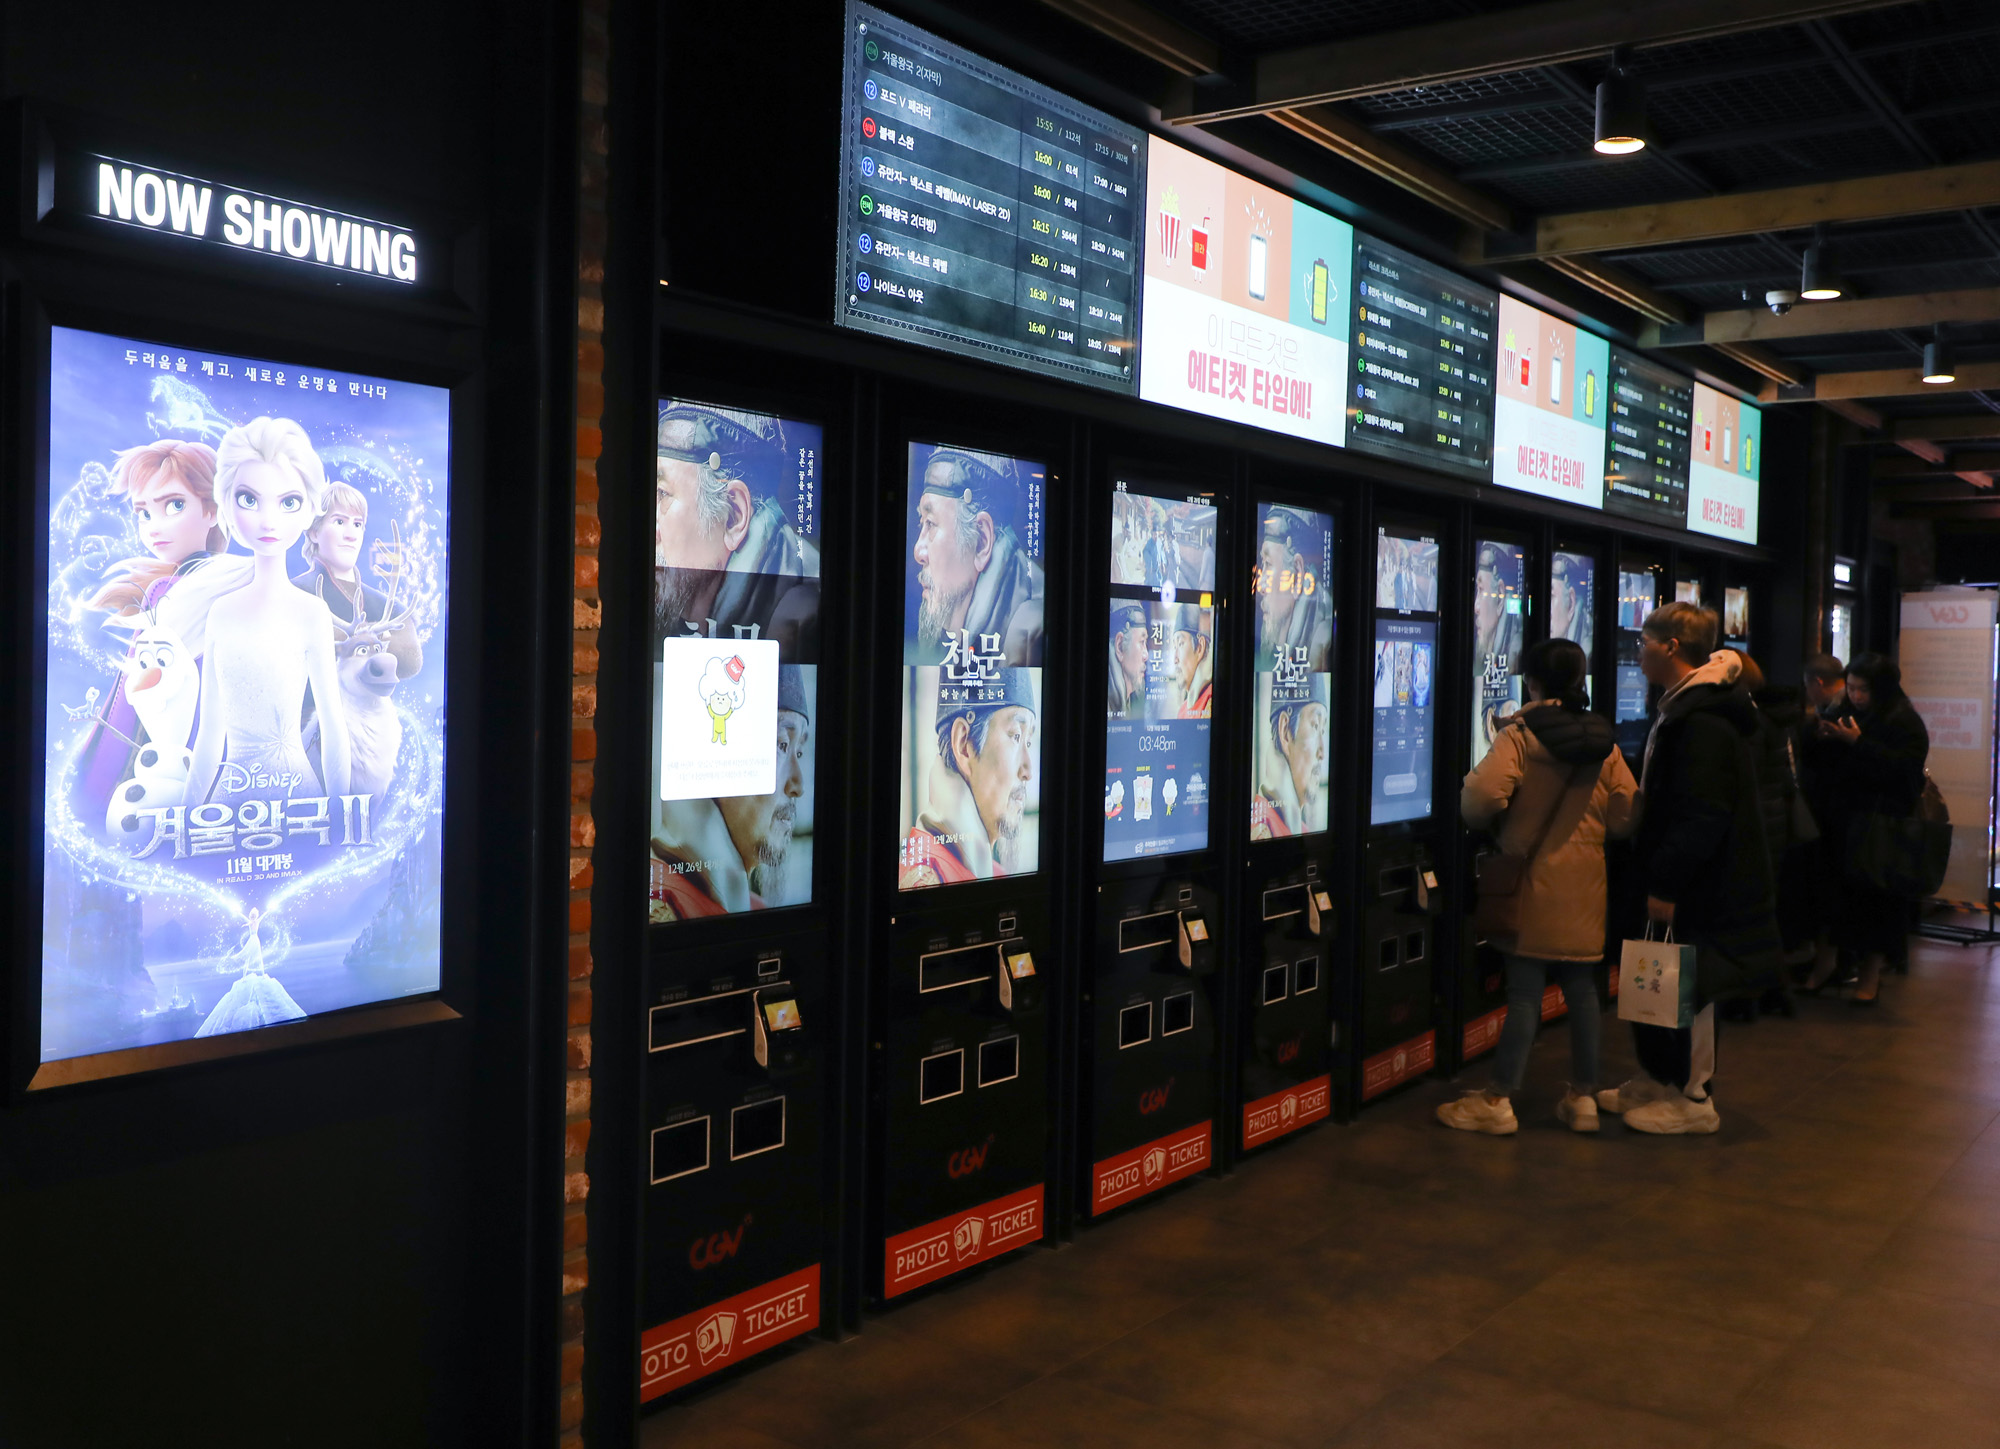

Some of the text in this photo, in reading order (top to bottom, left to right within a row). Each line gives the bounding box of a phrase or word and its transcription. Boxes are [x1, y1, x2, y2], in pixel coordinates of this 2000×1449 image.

[882, 50, 942, 86] 겨울왕국 2(자막)
[880, 88, 932, 120] 포드 V 페라리
[879, 126, 914, 151] 블랙 스완
[1036, 117, 1054, 132] 15:55
[1034, 150, 1053, 166] 16:00
[910, 175, 934, 194] 넥스트
[935, 184, 972, 208] 레벨(IMAX
[973, 198, 997, 217] LASER
[998, 206, 1010, 222] 2D)
[1033, 184, 1052, 200] 16:00
[98, 163, 417, 283] NOW SHOWING
[876, 203, 937, 234] 겨울왕국 2(더빙)
[1032, 219, 1050, 234] 16:15
[908, 250, 930, 268] 넥스트
[932, 258, 948, 274] 레벨
[1030, 254, 1048, 268] 16:20
[874, 278, 924, 304] 나이브스 아웃
[1030, 288, 1048, 302] 16:30
[1028, 322, 1046, 336] 16:40
[124, 350, 388, 400] 두려움을 깨고, 새로운 운명을 만나다
[1187, 350, 1312, 420] 에티켓 타임에!
[1517, 444, 1584, 490] 에티켓 타임에!
[806, 514, 812, 534] 시간
[1702, 498, 1722, 526] 에티켓
[796, 526, 804, 536] 두
[939, 628, 1006, 680] 천문
[1150, 620, 1164, 672] 천문
[1272, 642, 1310, 682] 천문
[940, 688, 969, 700] 하늘에
[1138, 735, 1176, 752] 03:48pm
[130, 794, 376, 860] 겨울왕국 II
[946, 833, 958, 844] 26일
[226, 853, 293, 874] 11월 대개봉
[668, 860, 703, 875] 12월 26일
[1248, 1091, 1326, 1132] PHOTO TICKET
[948, 1142, 988, 1180] CGV
[1100, 1140, 1204, 1195] PHOTO TICKET
[689, 1224, 745, 1270] CGV
[896, 1207, 1035, 1274] PHOTO TICKET
[644, 1294, 807, 1376] OTO TICKET
